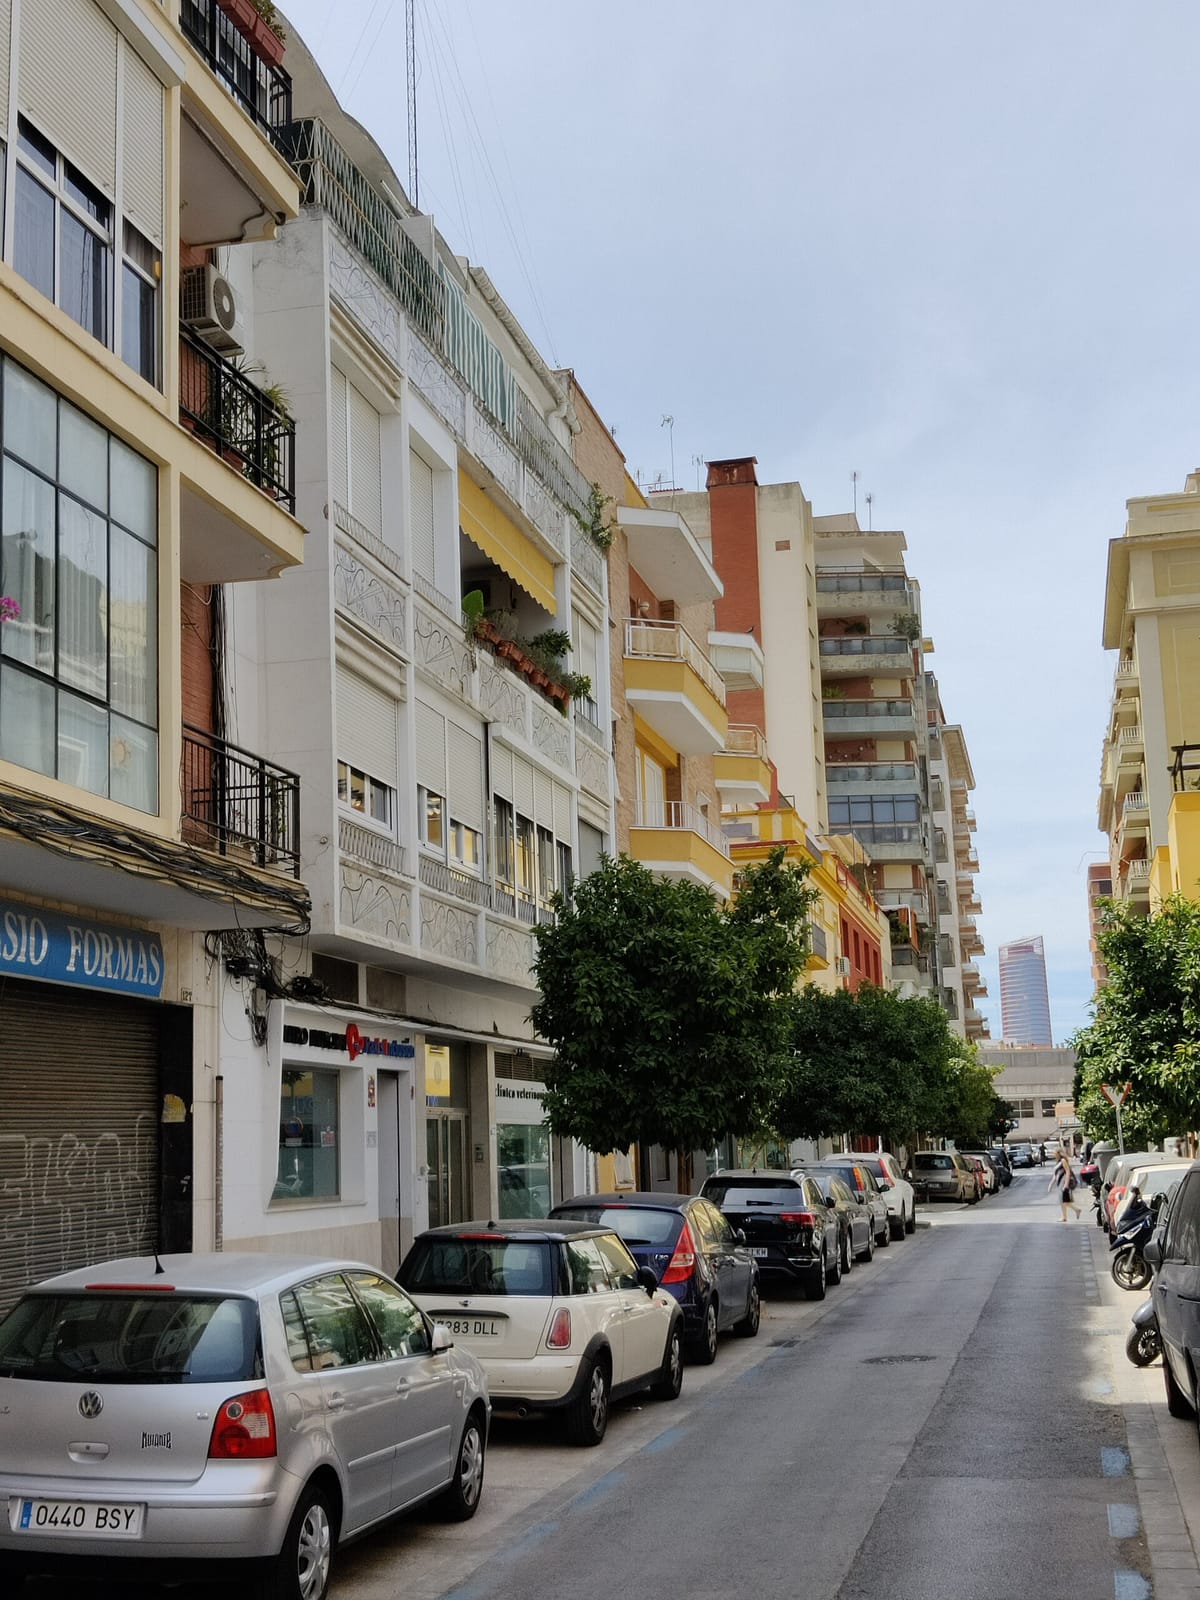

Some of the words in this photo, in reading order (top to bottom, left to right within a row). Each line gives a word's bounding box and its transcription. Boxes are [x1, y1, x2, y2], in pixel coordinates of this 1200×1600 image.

[0, 911, 49, 966] SIO
[65, 925, 161, 986] FORMAS
[473, 1321, 499, 1336] DLL
[36, 1505, 86, 1528] 0440
[95, 1507, 135, 1530] BSY
